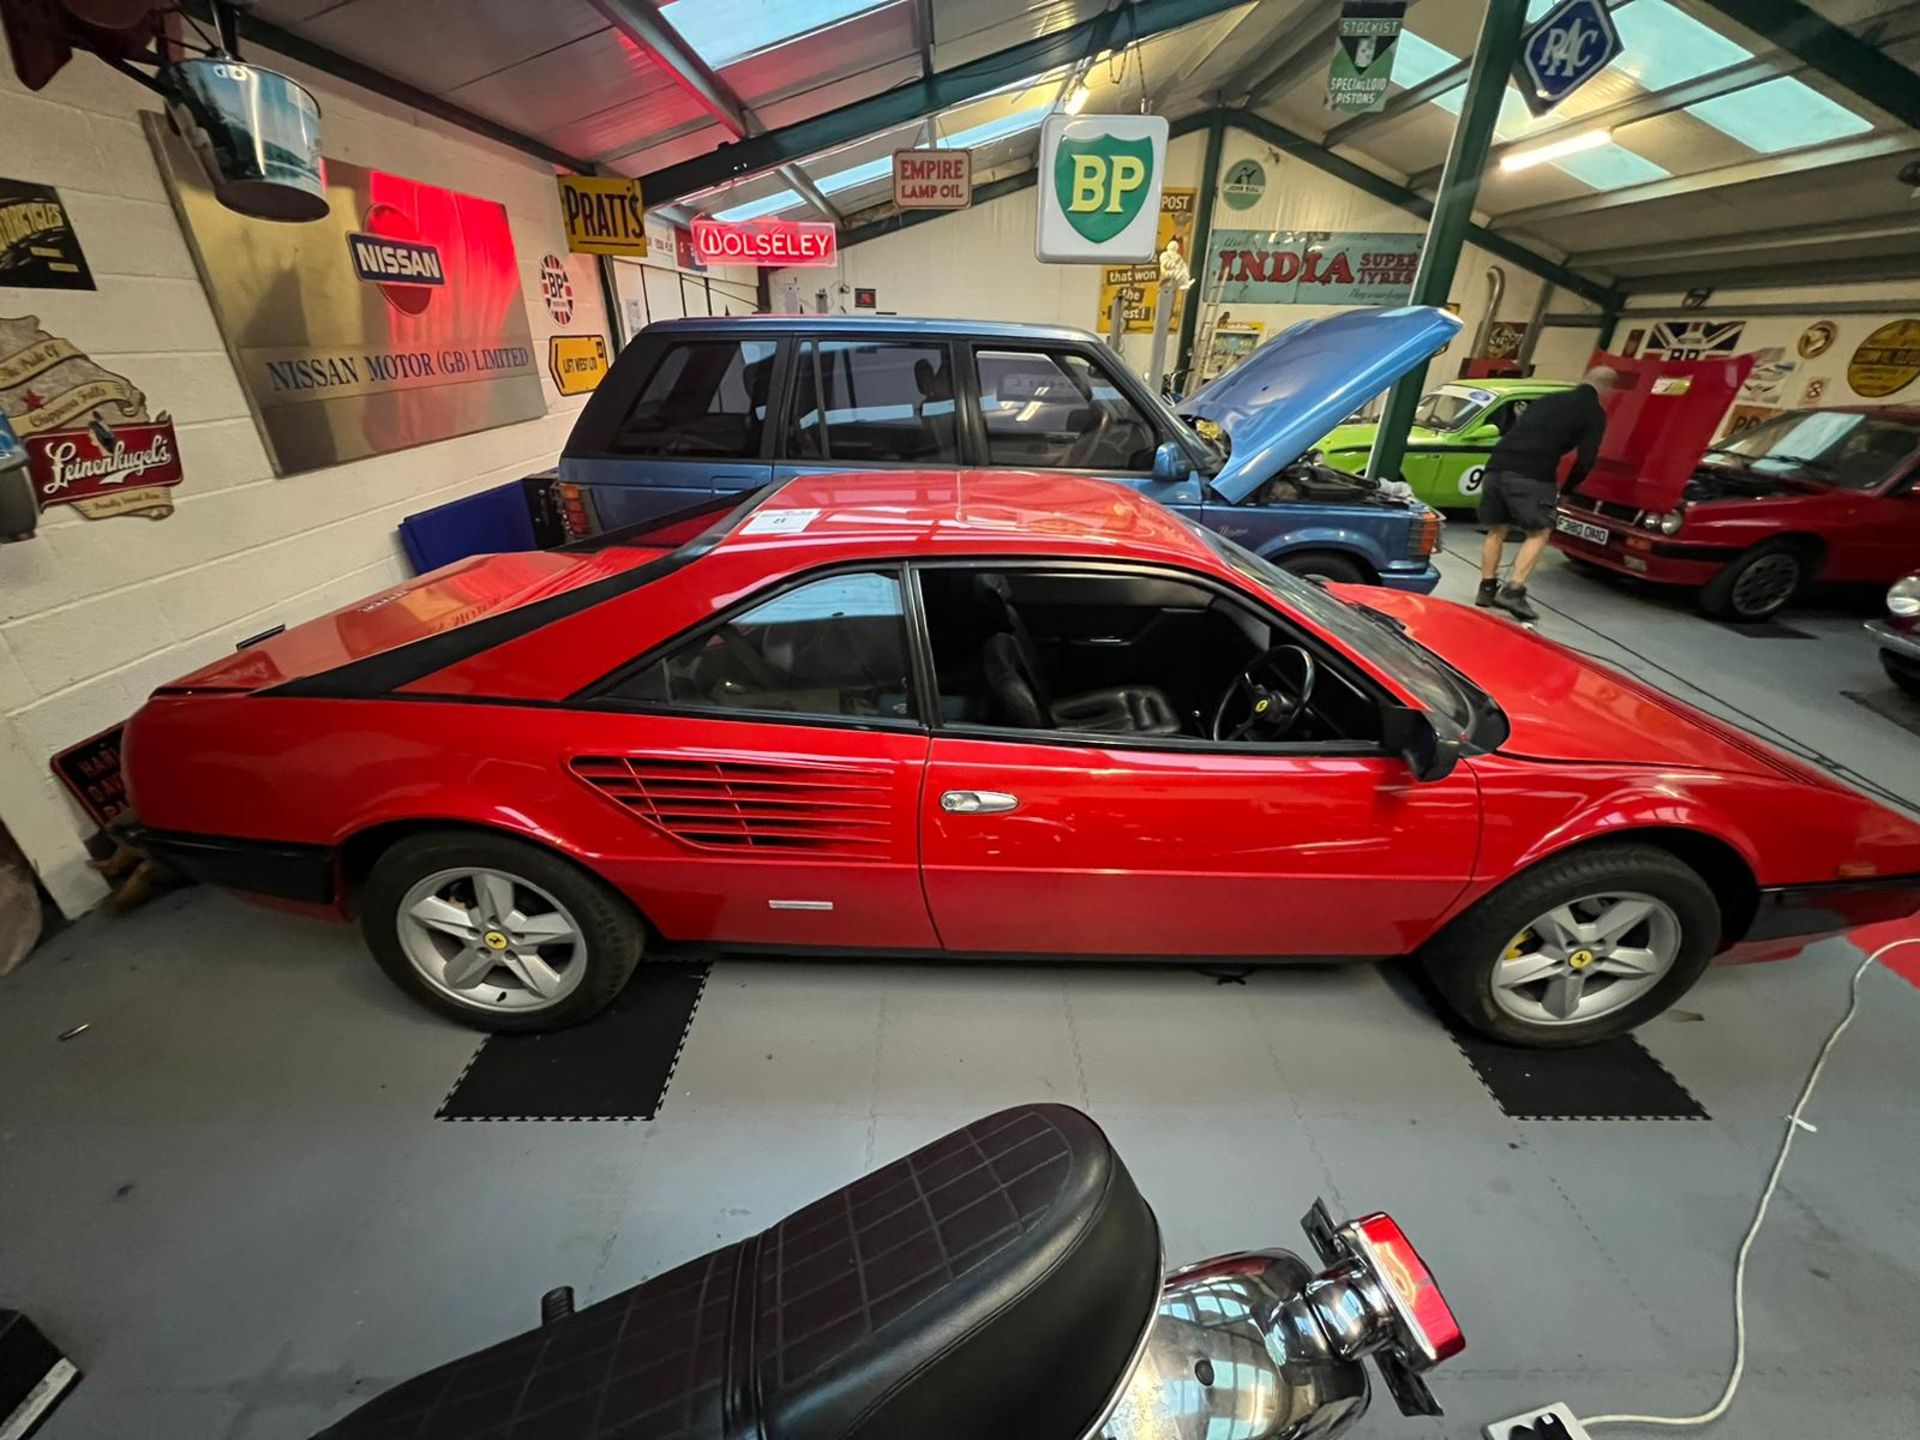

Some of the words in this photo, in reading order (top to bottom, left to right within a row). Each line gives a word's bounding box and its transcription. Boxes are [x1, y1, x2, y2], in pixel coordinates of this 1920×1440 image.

[1342, 21, 1398, 34] STOCKIST
[1537, 18, 1599, 77] RAC
[1335, 92, 1376, 104] PISTONS
[901, 160, 964, 180] EMPIRE
[1066, 153, 1145, 213] BP
[901, 185, 937, 199] LAMP
[940, 185, 964, 199] OIL
[700, 228, 831, 256] WOLSELEY
[355, 242, 441, 278] NISSAN
[1217, 250, 1354, 285] INDIA
[1360, 253, 1418, 266] SUPER
[547, 271, 564, 299] BP
[1109, 272, 1133, 282] that
[1134, 269, 1157, 281] won
[267, 358, 360, 391] NISSAN
[364, 353, 433, 382] MOTOR
[436, 350, 469, 374] (GB)
[473, 347, 529, 371] LIMITED
[43, 435, 171, 494] Leinenkugel's
[1466, 468, 1483, 491] 9
